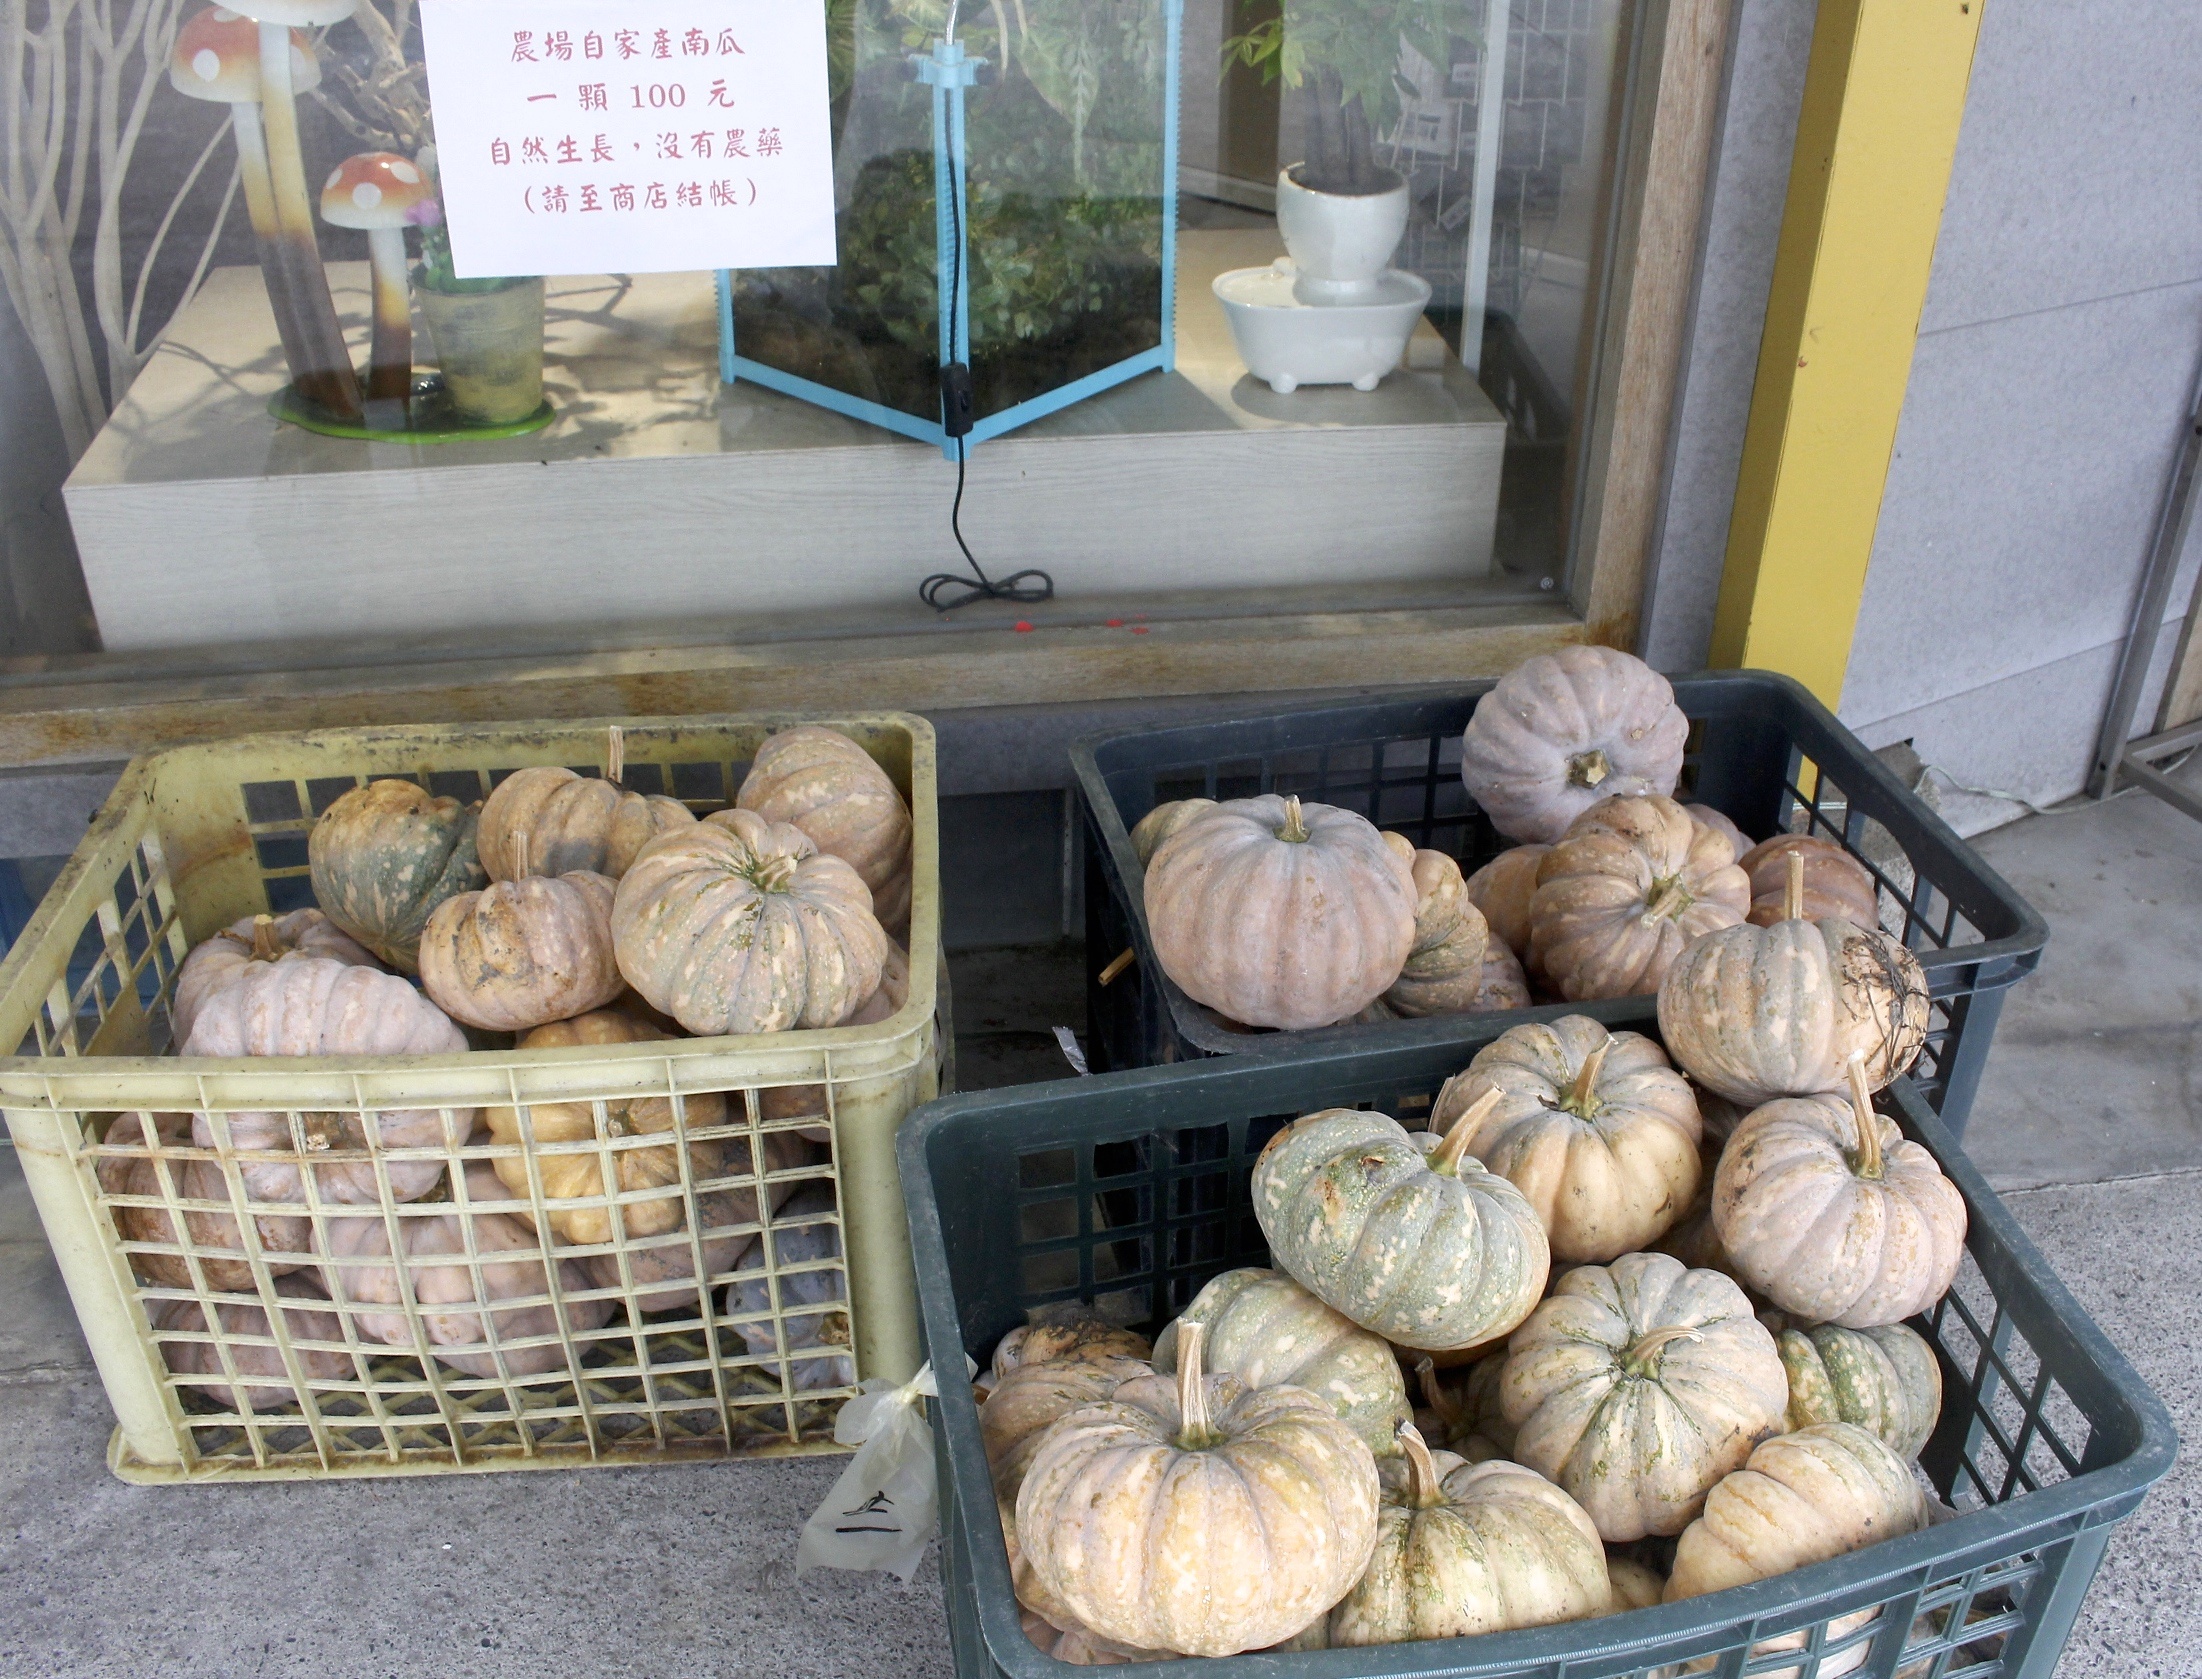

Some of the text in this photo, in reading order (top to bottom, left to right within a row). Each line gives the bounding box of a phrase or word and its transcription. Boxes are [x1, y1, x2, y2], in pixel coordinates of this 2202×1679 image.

[512, 28, 745, 62] 農場自家產南瓜
[579, 83, 608, 111] 顆
[630, 84, 686, 109] 100
[708, 79, 735, 108] 元
